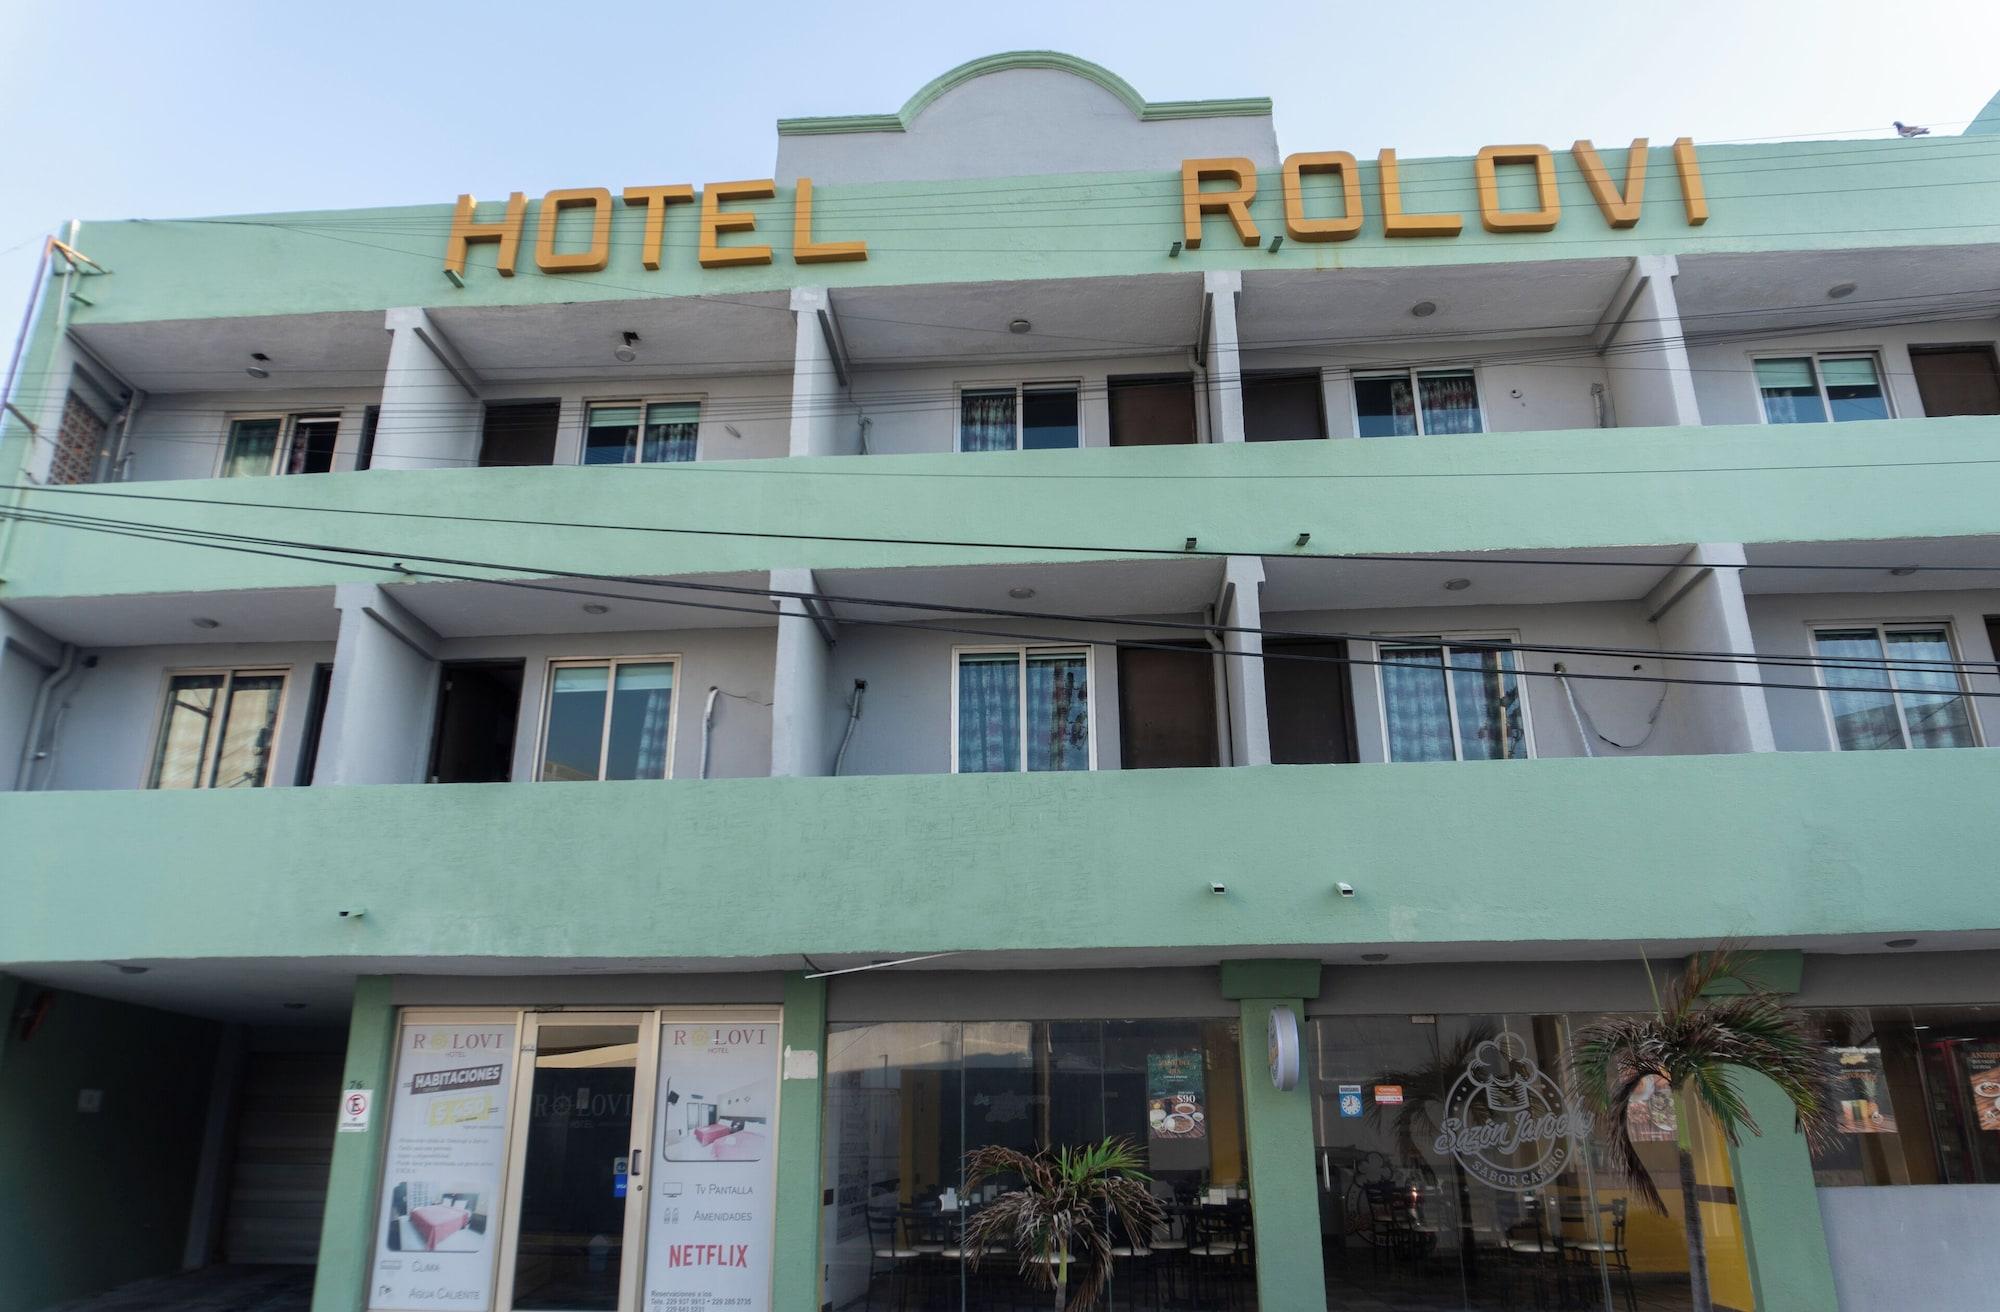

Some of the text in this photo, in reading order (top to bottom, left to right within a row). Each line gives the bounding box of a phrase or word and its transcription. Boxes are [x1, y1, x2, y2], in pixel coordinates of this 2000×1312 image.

[444, 137, 1709, 277] HOTEL ROLOVI
[414, 1066, 501, 1089] HABITACIONES
[1176, 1094, 1197, 1104] $90
[1433, 1117, 1511, 1155] Sazón
[1471, 1148, 1566, 1187] SABOR CASERO
[669, 1244, 749, 1268] NETFLIX
